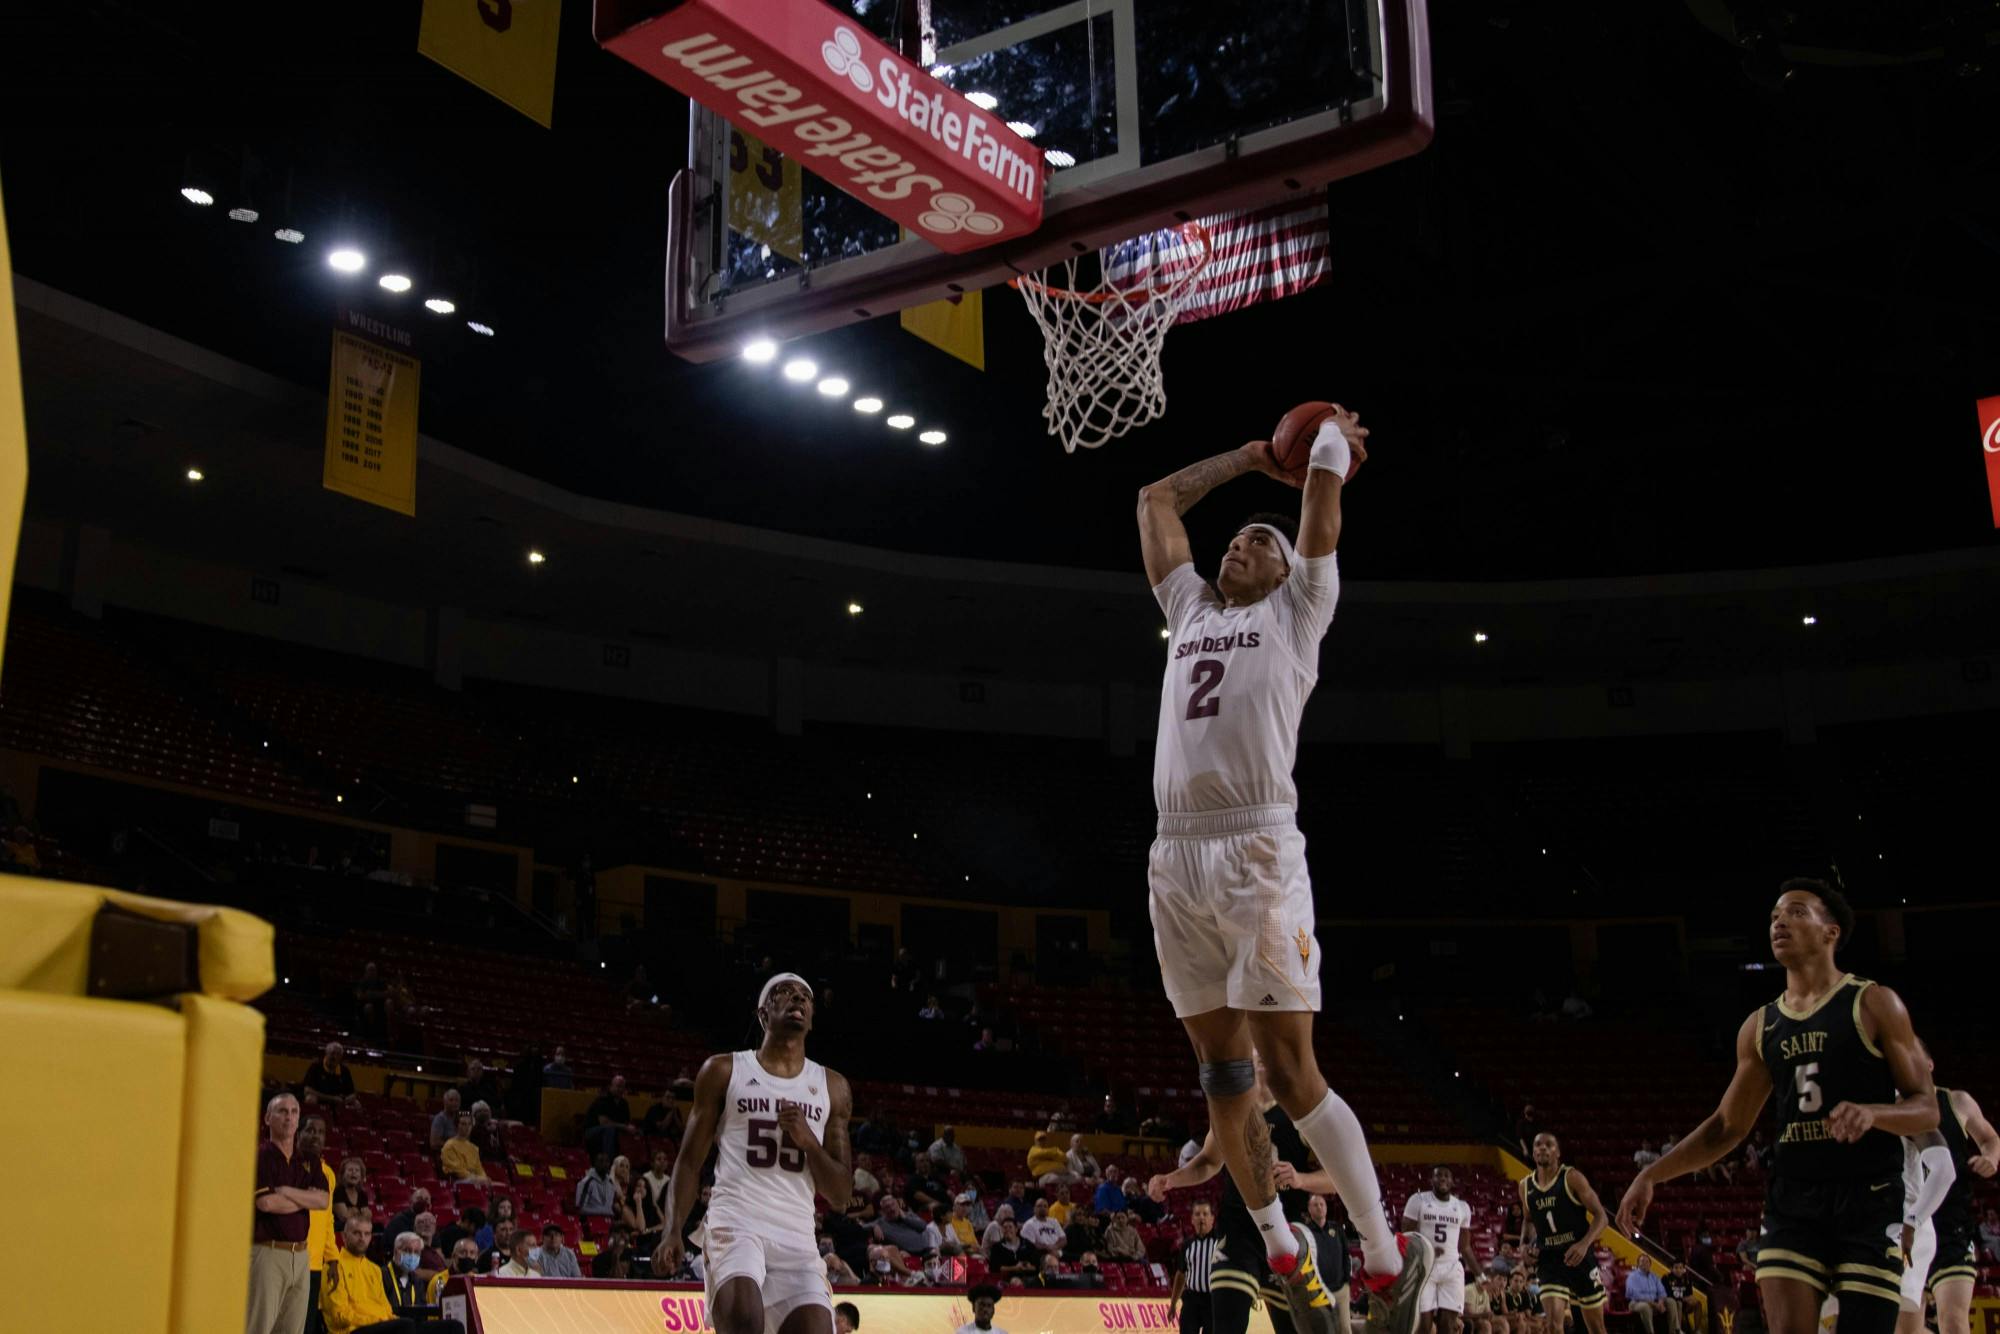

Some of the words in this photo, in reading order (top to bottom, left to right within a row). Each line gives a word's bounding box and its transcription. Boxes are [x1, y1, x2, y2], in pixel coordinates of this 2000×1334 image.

[349, 309, 412, 347] WRESTLING
[1186, 659, 1225, 721] 2
[1780, 1031, 1828, 1060] SAINT
[1795, 1061, 1823, 1115] 5
[737, 1097, 770, 1113] SUN
[746, 1118, 805, 1173] 55
[1535, 1196, 1557, 1211] SAINT
[1434, 1223, 1447, 1243] 5
[1546, 1210, 1558, 1233] 1
[1099, 1302, 1137, 1329] SUN
